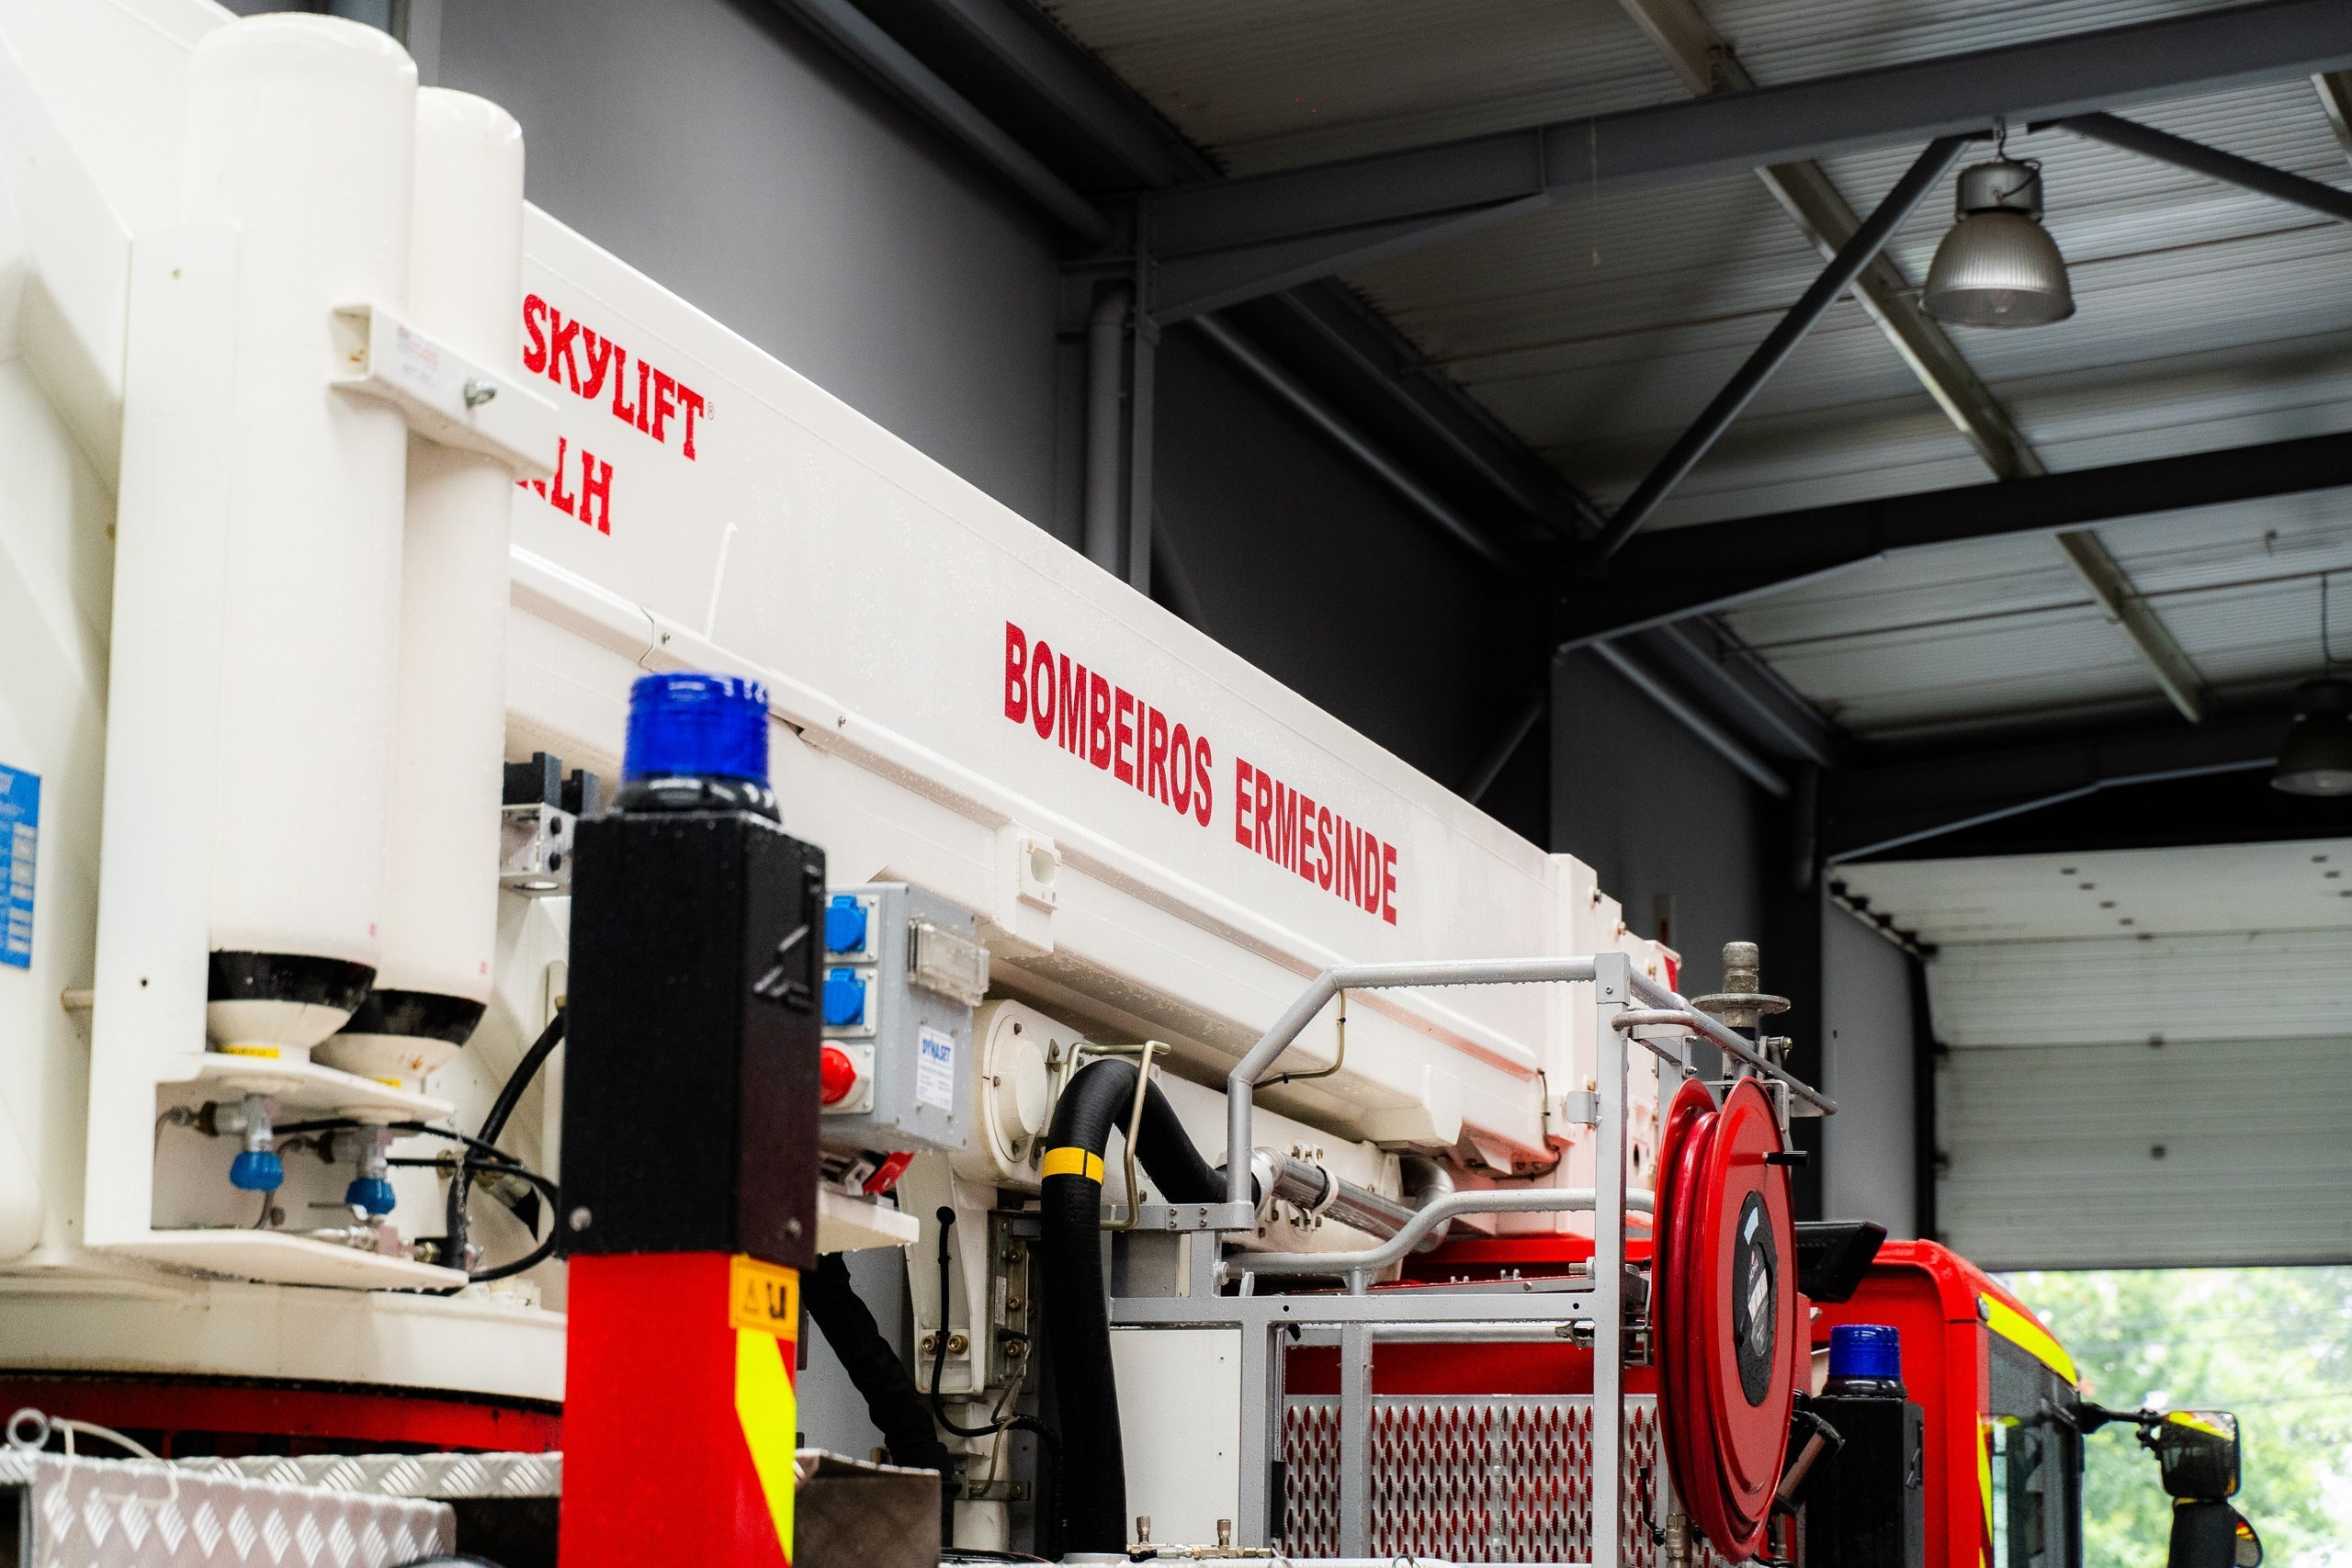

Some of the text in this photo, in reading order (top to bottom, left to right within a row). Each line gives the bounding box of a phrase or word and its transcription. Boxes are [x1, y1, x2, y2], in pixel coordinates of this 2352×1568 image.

[515, 435, 614, 536] LH
[1004, 620, 1397, 927] BOMBEIROS ERMESINDE
